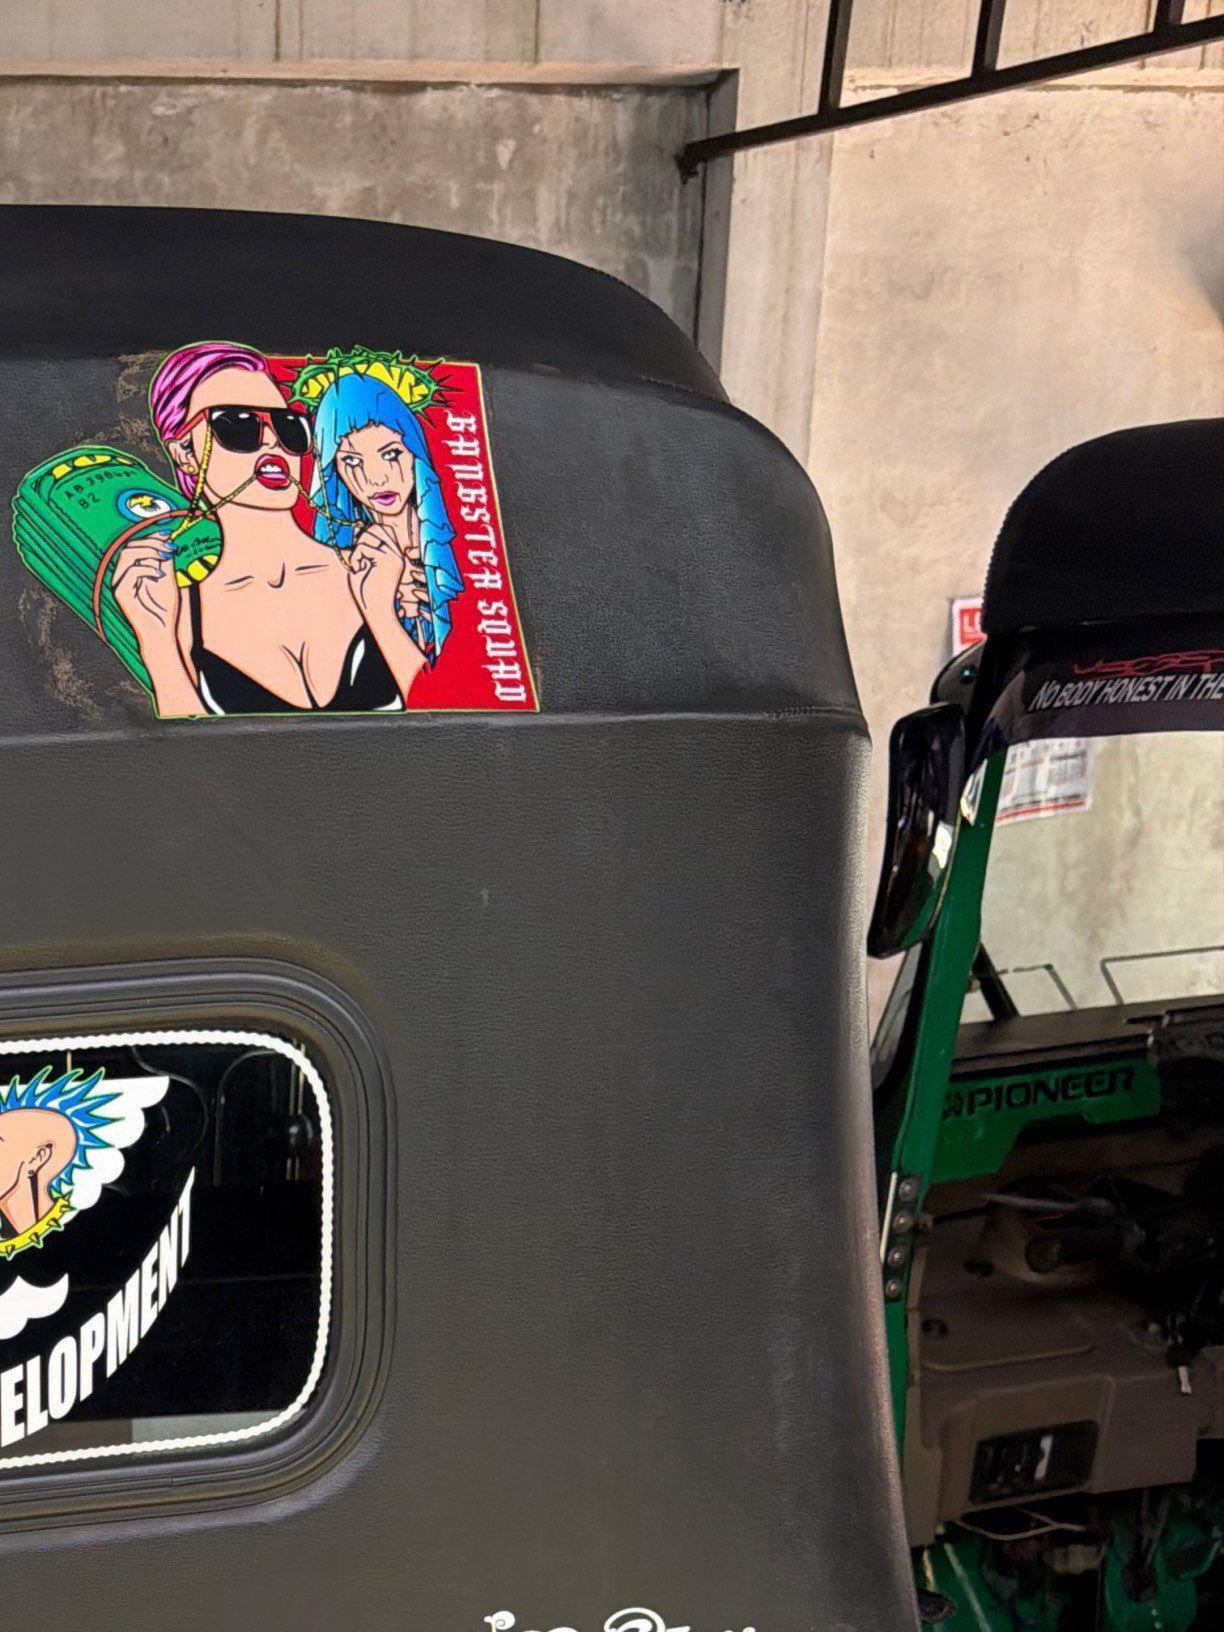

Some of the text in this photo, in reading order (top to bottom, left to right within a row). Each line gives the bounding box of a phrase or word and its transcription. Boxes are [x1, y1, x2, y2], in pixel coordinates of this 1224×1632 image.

[446, 411, 527, 703] GANGSTER SQUAD
[1096, 674, 1174, 705] HONEST
[1165, 673, 1198, 700] IN
